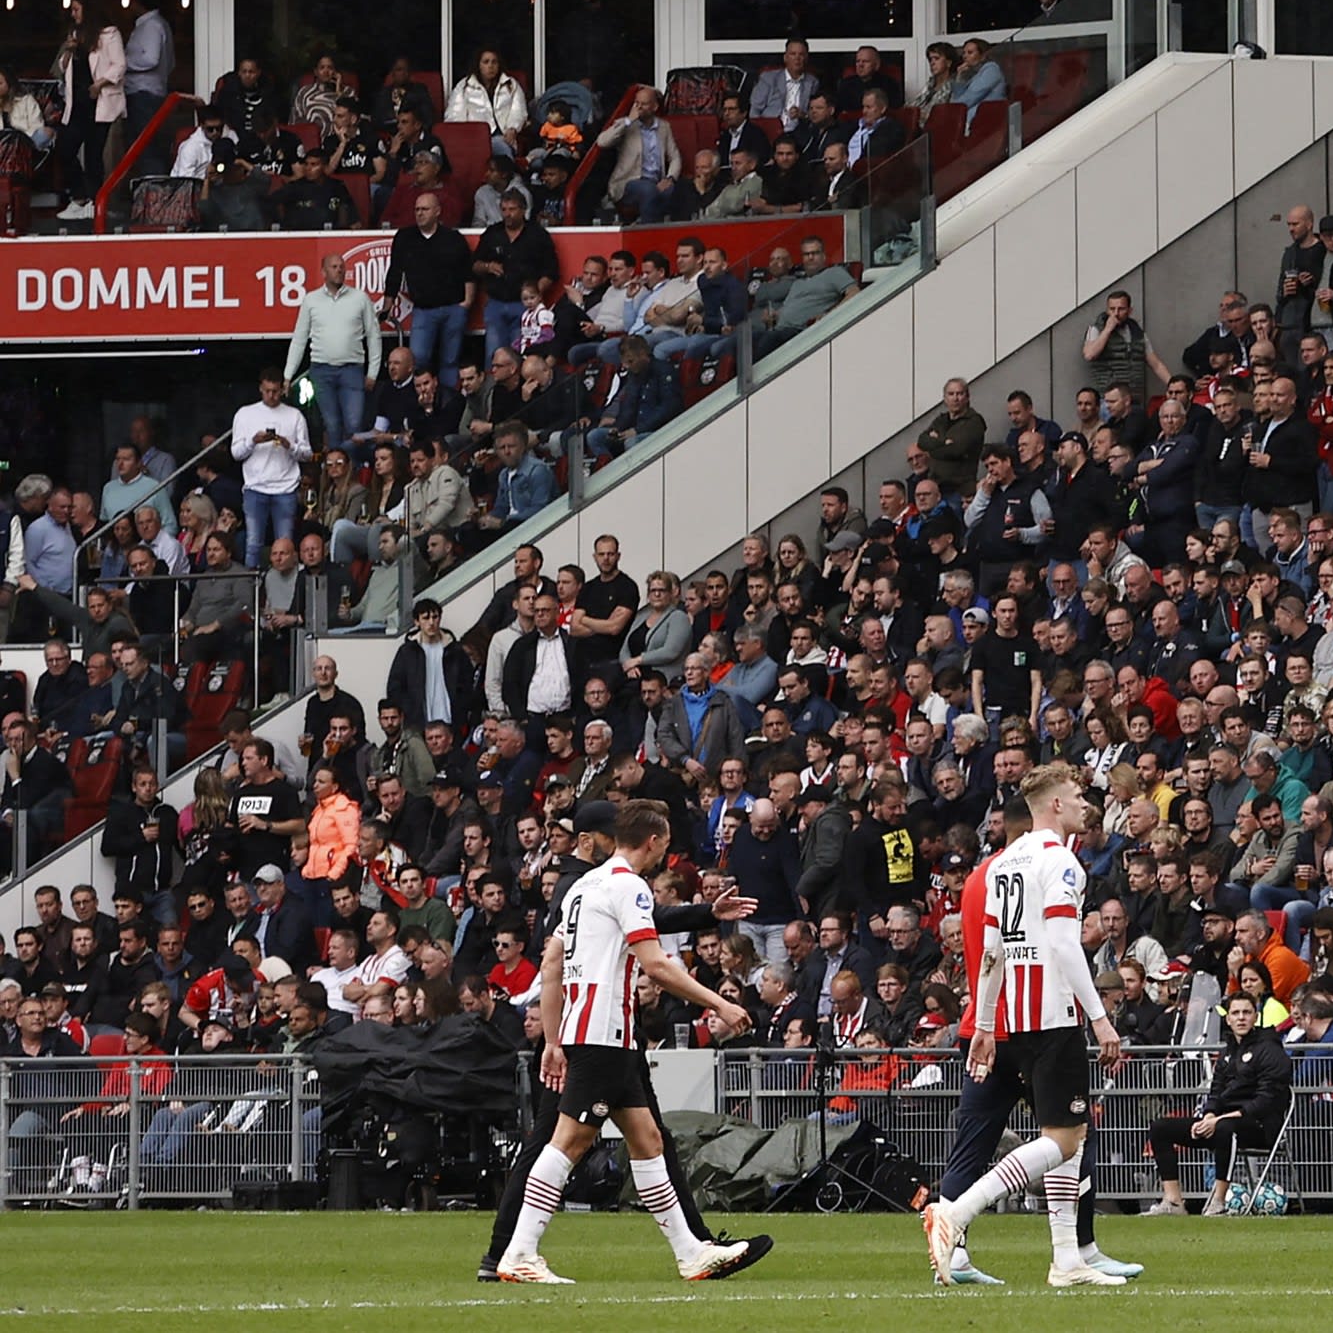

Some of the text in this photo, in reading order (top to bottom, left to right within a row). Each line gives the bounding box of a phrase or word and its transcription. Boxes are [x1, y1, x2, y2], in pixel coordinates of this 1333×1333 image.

[17, 265, 305, 311] DOMMEL 18
[240, 798, 263, 811] 1913
[563, 894, 583, 961] 9
[994, 871, 1026, 943] 22
